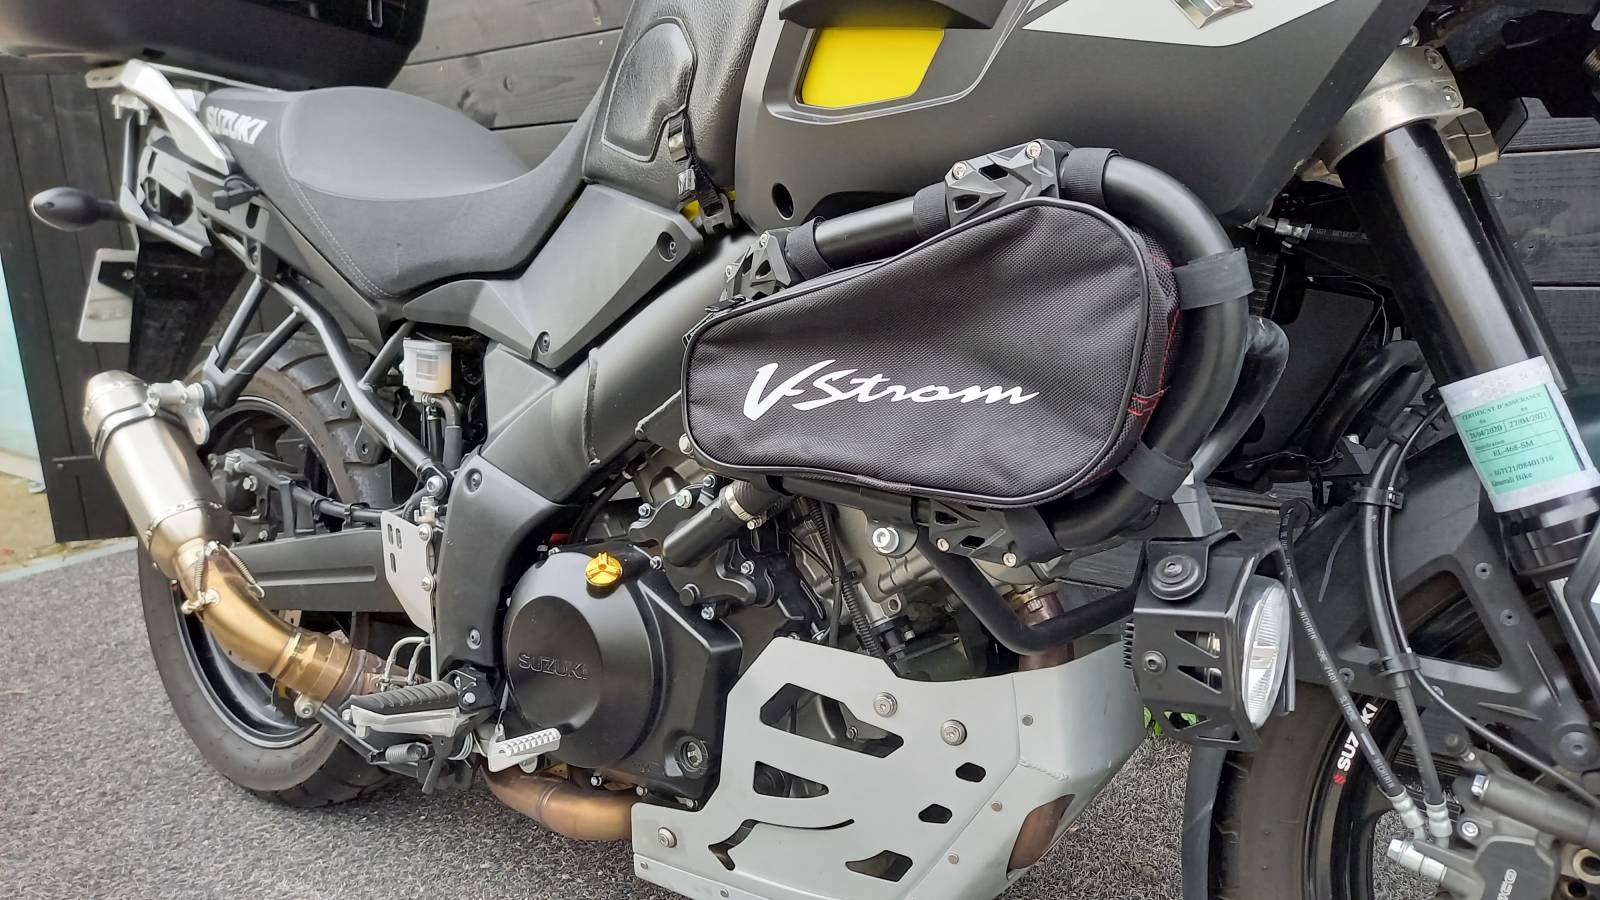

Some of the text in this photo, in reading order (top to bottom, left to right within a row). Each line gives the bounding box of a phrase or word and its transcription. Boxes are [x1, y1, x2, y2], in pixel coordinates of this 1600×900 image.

[206, 106, 268, 145] SUZUKI
[743, 358, 1039, 421] V-Strom
[518, 652, 591, 681] SUZUKI
[1337, 702, 1378, 772] SUZKI
